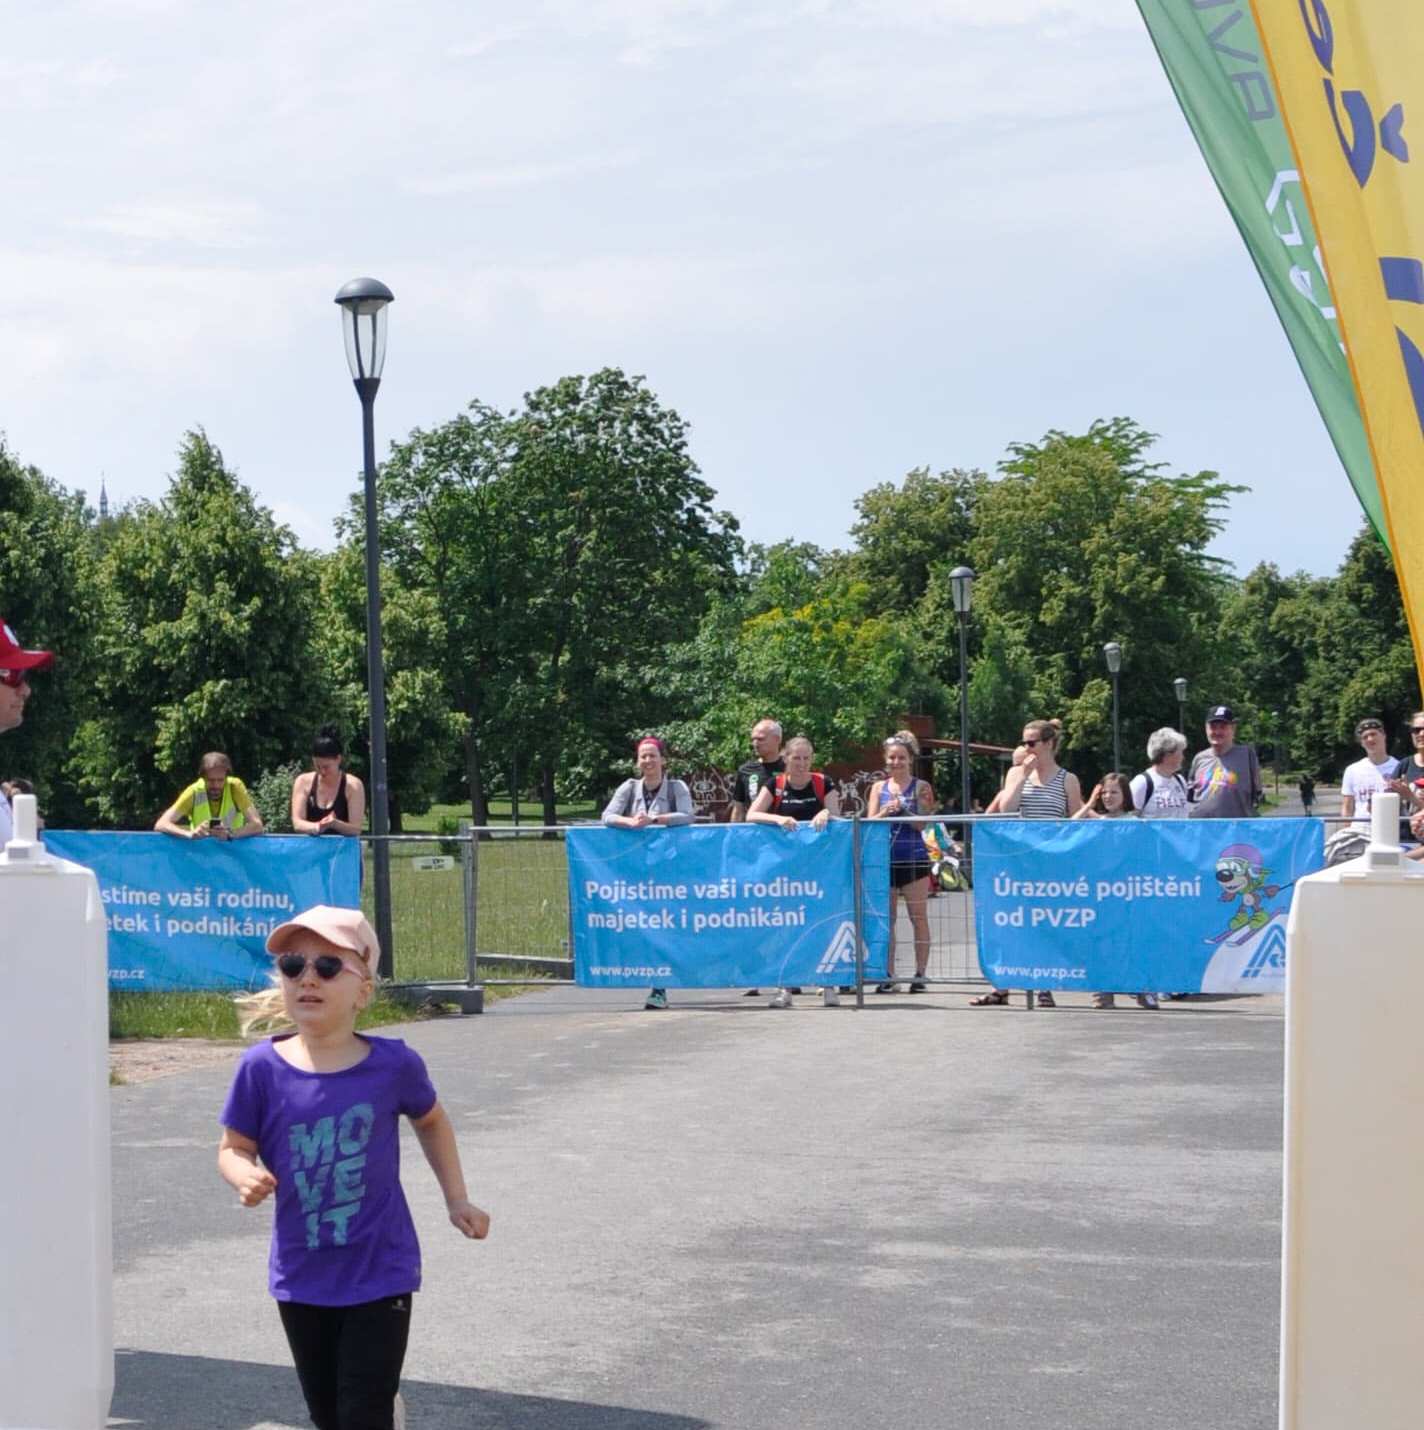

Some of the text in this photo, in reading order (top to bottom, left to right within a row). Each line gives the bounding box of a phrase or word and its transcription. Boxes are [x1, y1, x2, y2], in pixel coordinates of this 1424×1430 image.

[101, 885, 296, 912] stíme vaši rodinu,
[585, 876, 824, 904] Pojistíme vaši rodinu,
[994, 872, 1201, 901] Úrazové pojištění
[106, 913, 275, 937] etek i podnikání
[588, 904, 806, 932] majetek i podnikání
[994, 906, 1096, 928] od PVZP
[590, 965, 672, 978] www.pvzp.cz
[994, 965, 1087, 979] www.pvzp.cz
[289, 1103, 374, 1171] MO
[294, 1153, 367, 1214] VE
[306, 1201, 362, 1251] IT
